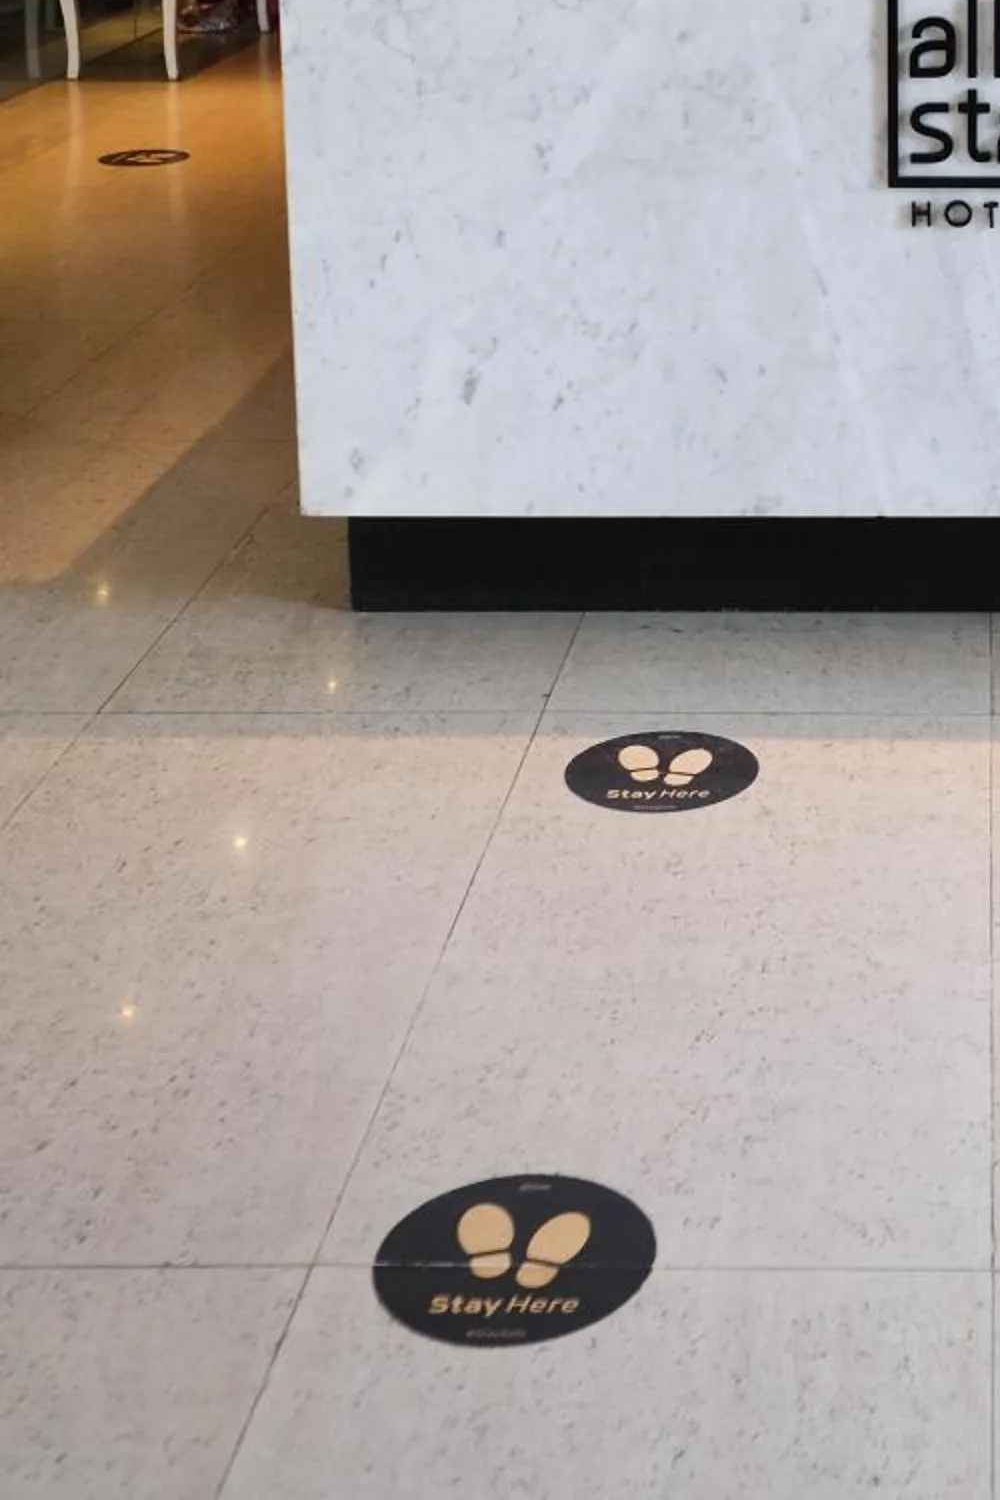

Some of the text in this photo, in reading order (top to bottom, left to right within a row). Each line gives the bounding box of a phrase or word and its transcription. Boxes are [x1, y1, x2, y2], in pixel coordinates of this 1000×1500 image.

[606, 788, 711, 800] Stay Here
[428, 1293, 580, 1317] Stay Here
